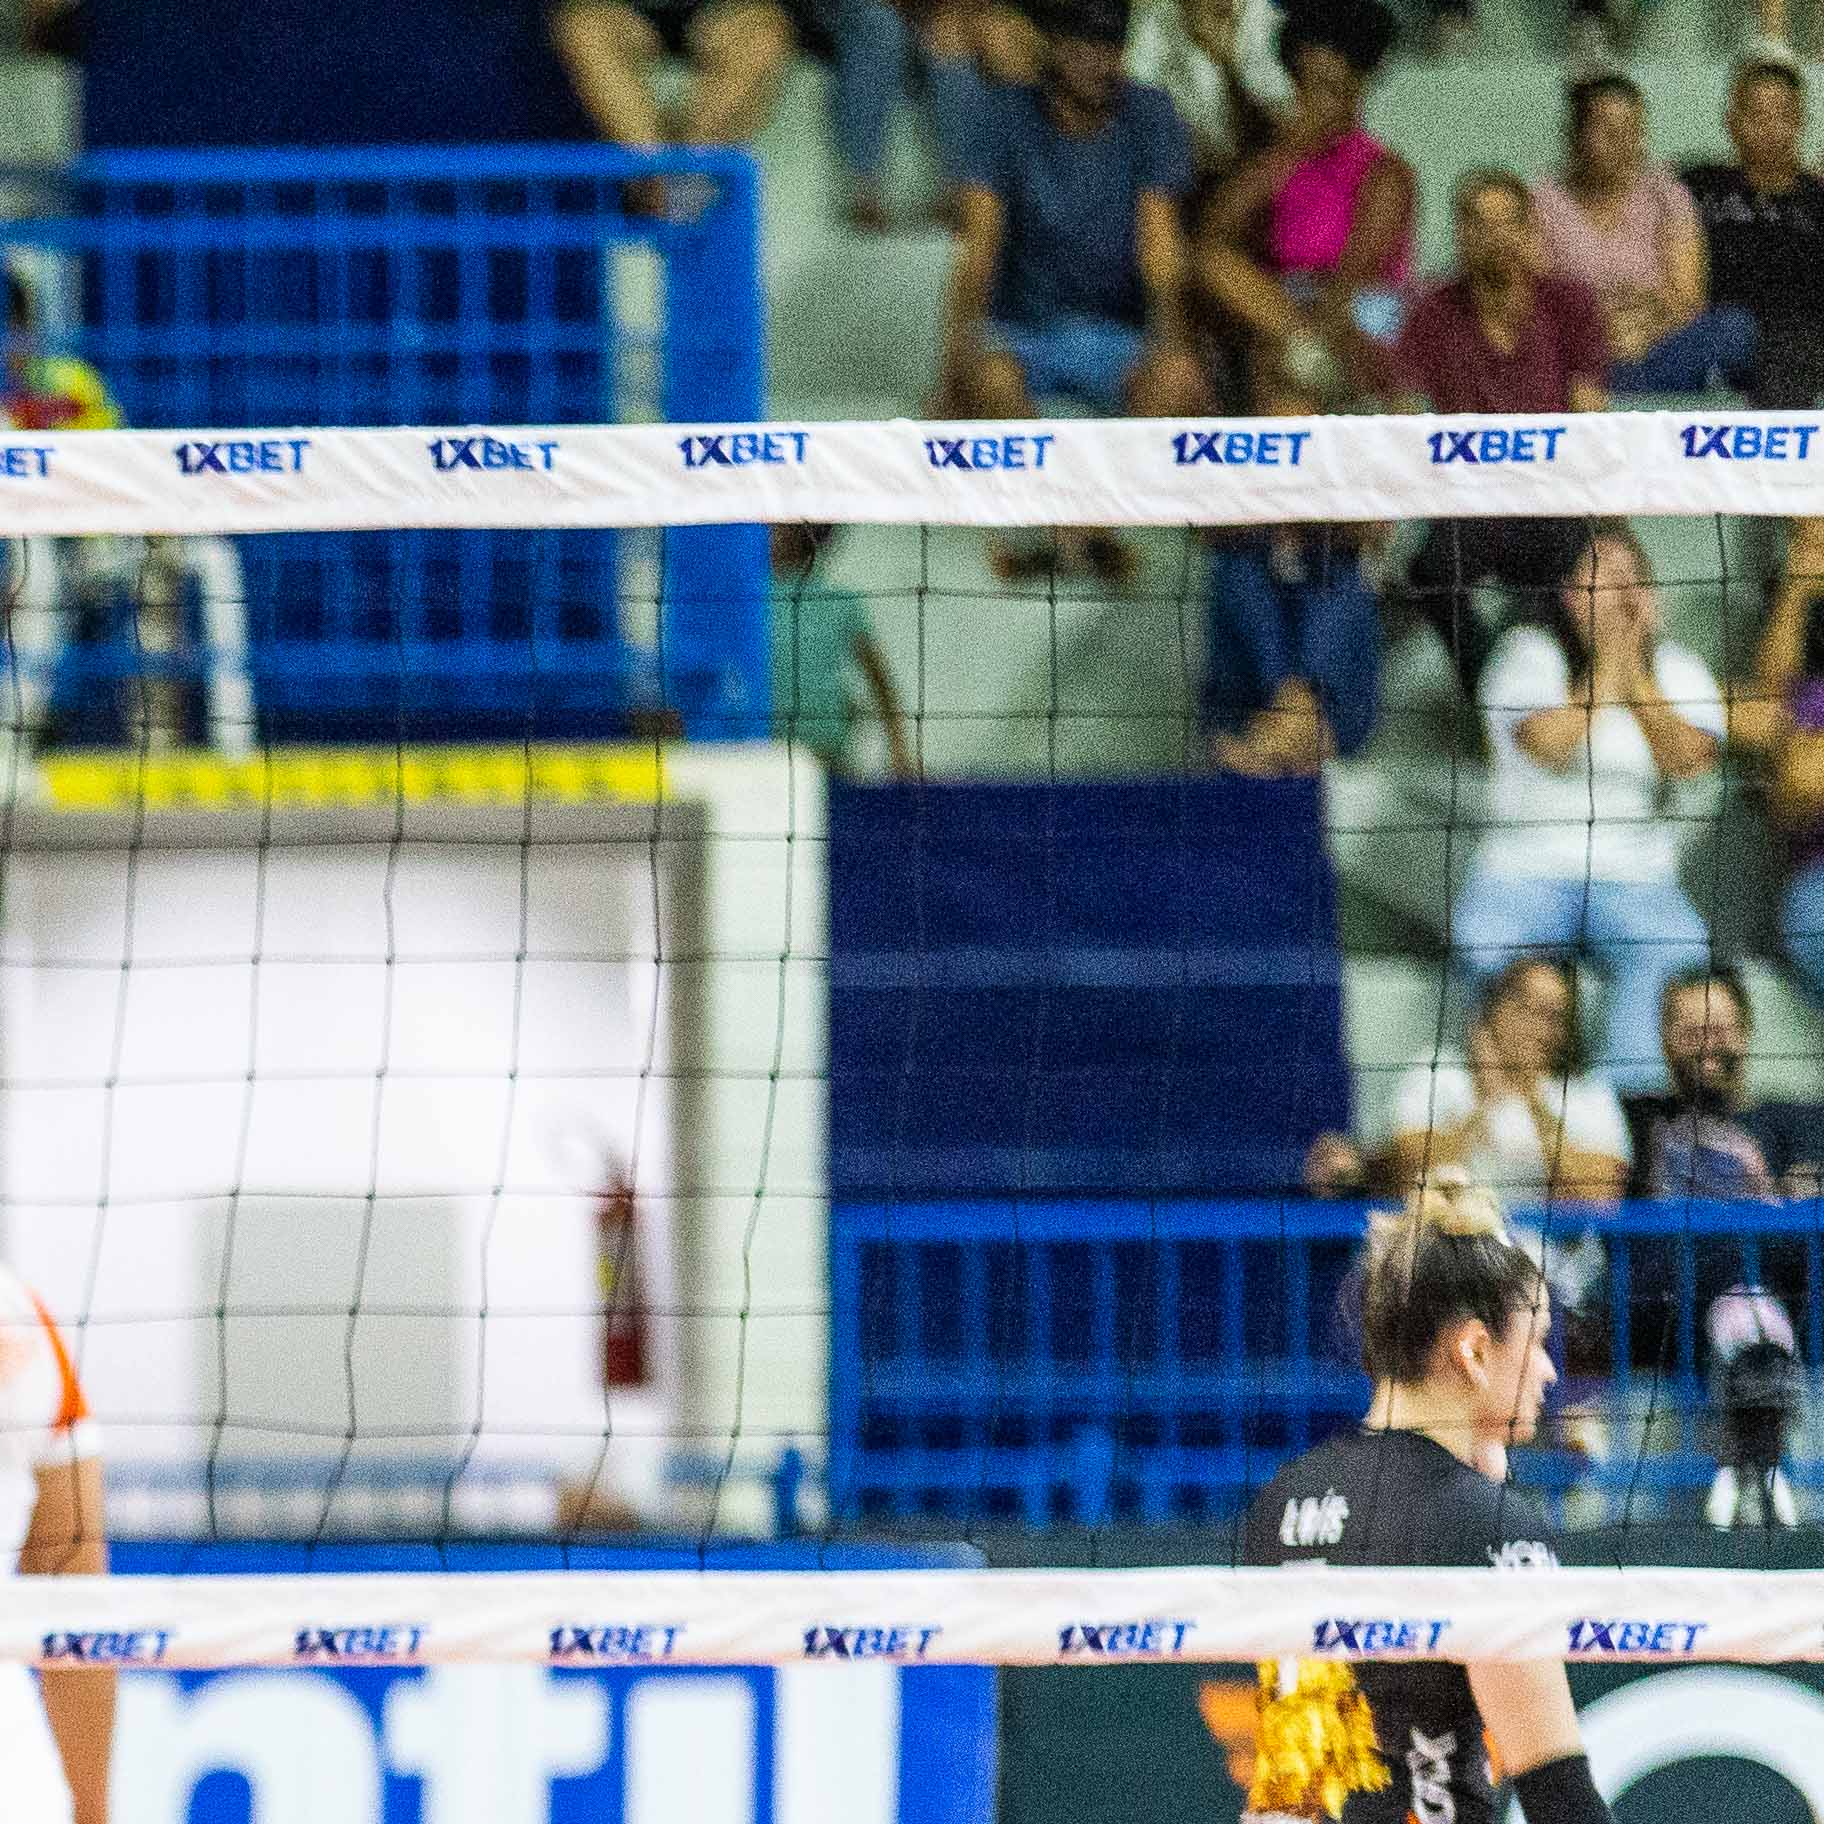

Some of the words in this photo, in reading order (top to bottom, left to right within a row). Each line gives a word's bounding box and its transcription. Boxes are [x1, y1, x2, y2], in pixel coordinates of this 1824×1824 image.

[172, 437, 313, 476] 1XBET
[426, 434, 562, 473] 1XBET
[675, 430, 811, 470] 1XBET
[921, 433, 1057, 472] 1XBET
[1169, 430, 1314, 467] 1XBET
[1425, 425, 1569, 465] 1XBET
[1678, 423, 1822, 462] 1XBET
[40, 1629, 173, 1661] 1XBET
[294, 1624, 424, 1657] 1XBET
[548, 1624, 683, 1662] 1XBET
[801, 1625, 941, 1661] 1XBET
[1057, 1619, 1196, 1655] 1XBET
[1313, 1618, 1451, 1653] 1XBET
[1567, 1619, 1708, 1654] 1XBET
